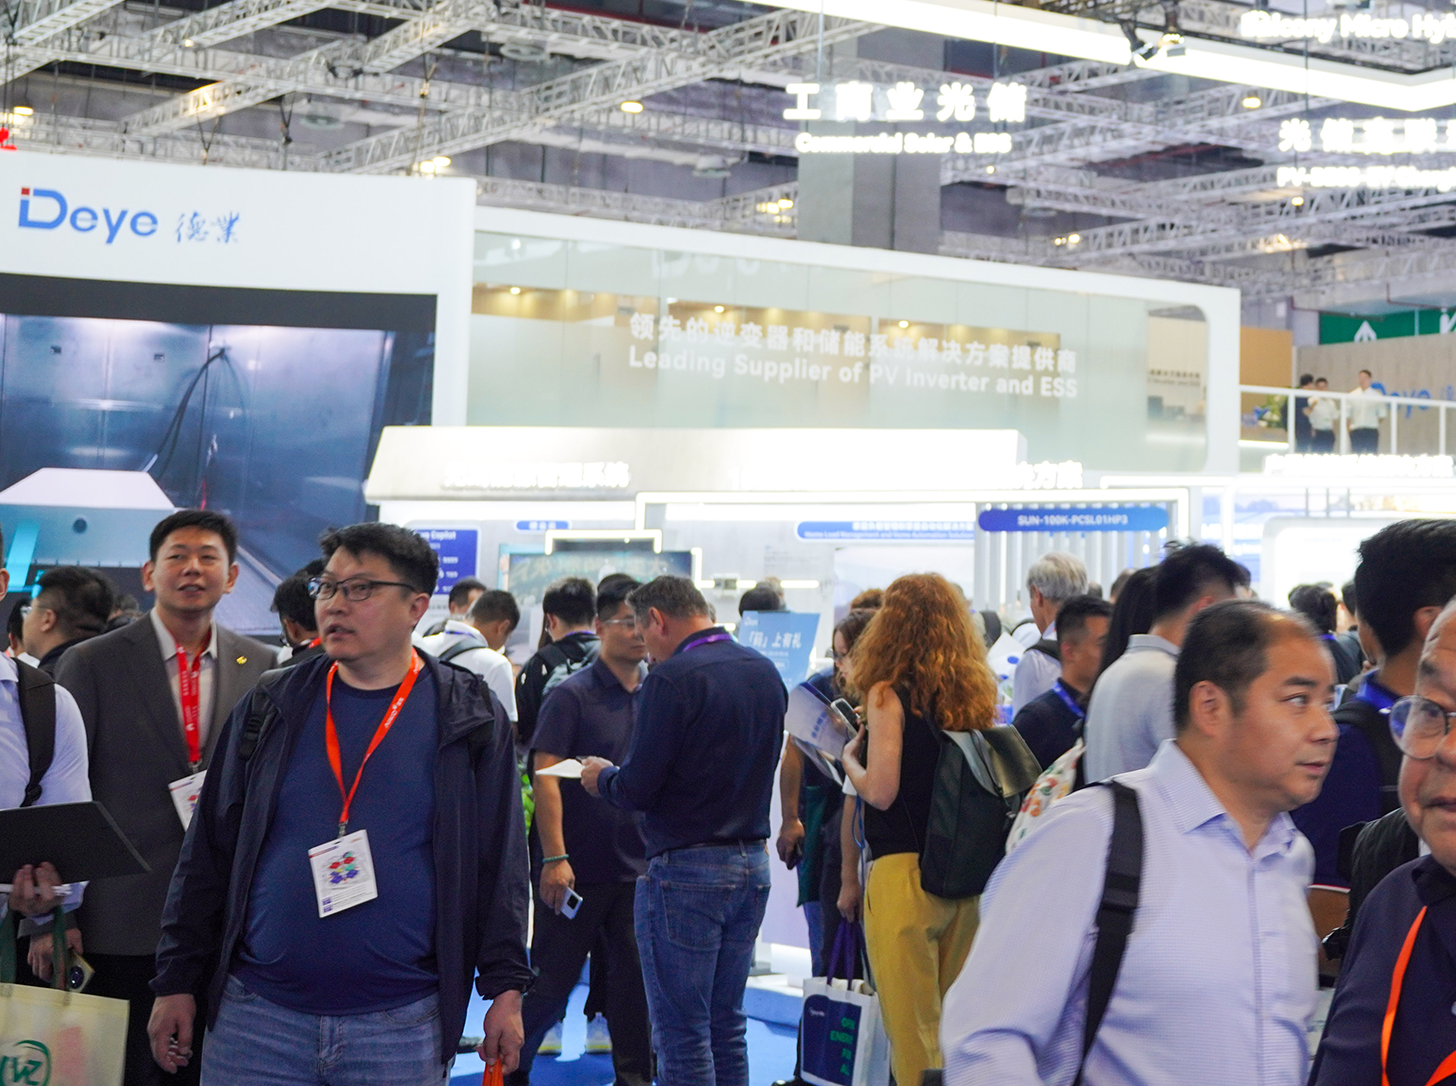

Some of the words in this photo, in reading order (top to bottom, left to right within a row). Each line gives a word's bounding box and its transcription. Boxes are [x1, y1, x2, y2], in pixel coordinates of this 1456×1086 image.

[1340, 13, 1409, 39] Micro
[795, 131, 903, 154] Commercial
[903, 132, 955, 154] Solar
[955, 132, 973, 154] &
[18, 186, 159, 245] Deye
[629, 344, 726, 379] Leading
[734, 353, 832, 385] Supplier
[838, 361, 862, 384] of
[869, 365, 899, 387] PV
[905, 368, 989, 393] Inverter
[995, 375, 1034, 397] and
[1040, 377, 1078, 399] ESS
